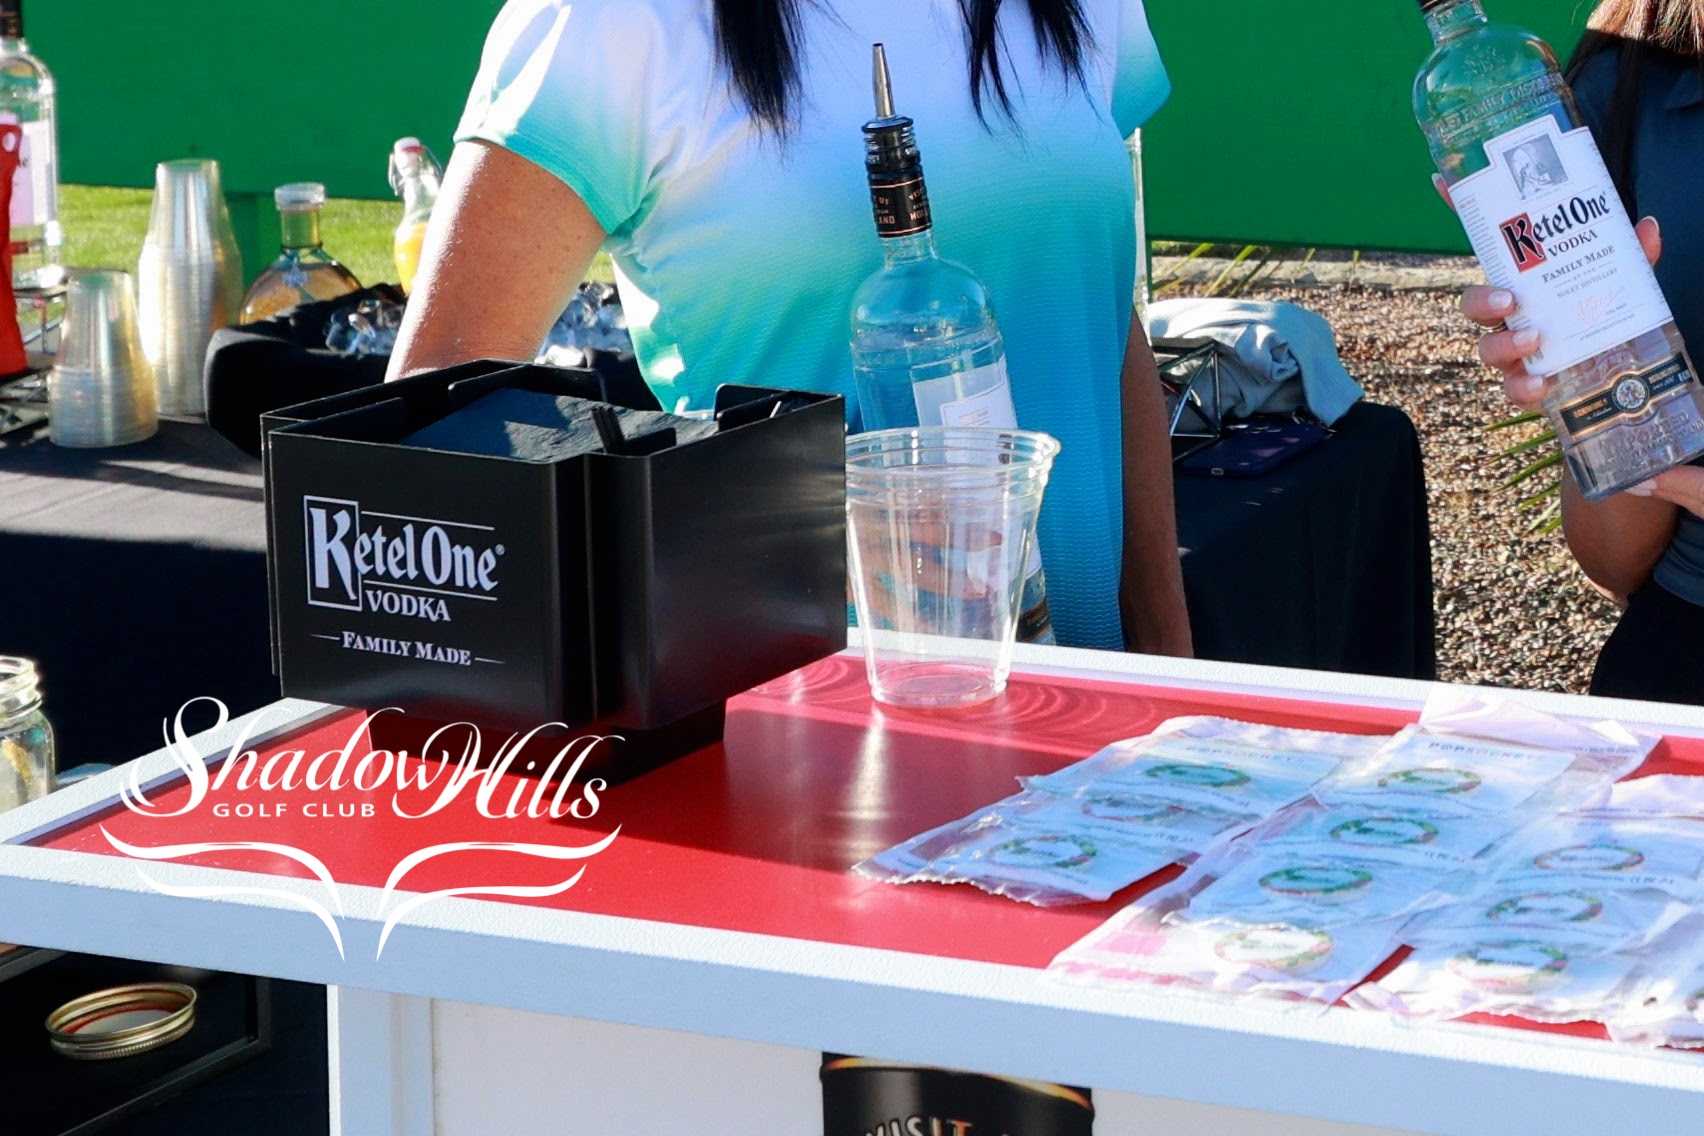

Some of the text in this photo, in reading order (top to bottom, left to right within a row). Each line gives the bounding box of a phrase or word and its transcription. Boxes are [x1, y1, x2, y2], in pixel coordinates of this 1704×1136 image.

[1548, 229, 1598, 257] VODKA
[1542, 245, 1616, 283] FAMILY MADE
[365, 589, 451, 622] VODKA
[342, 631, 472, 665] FAMILY MADE
